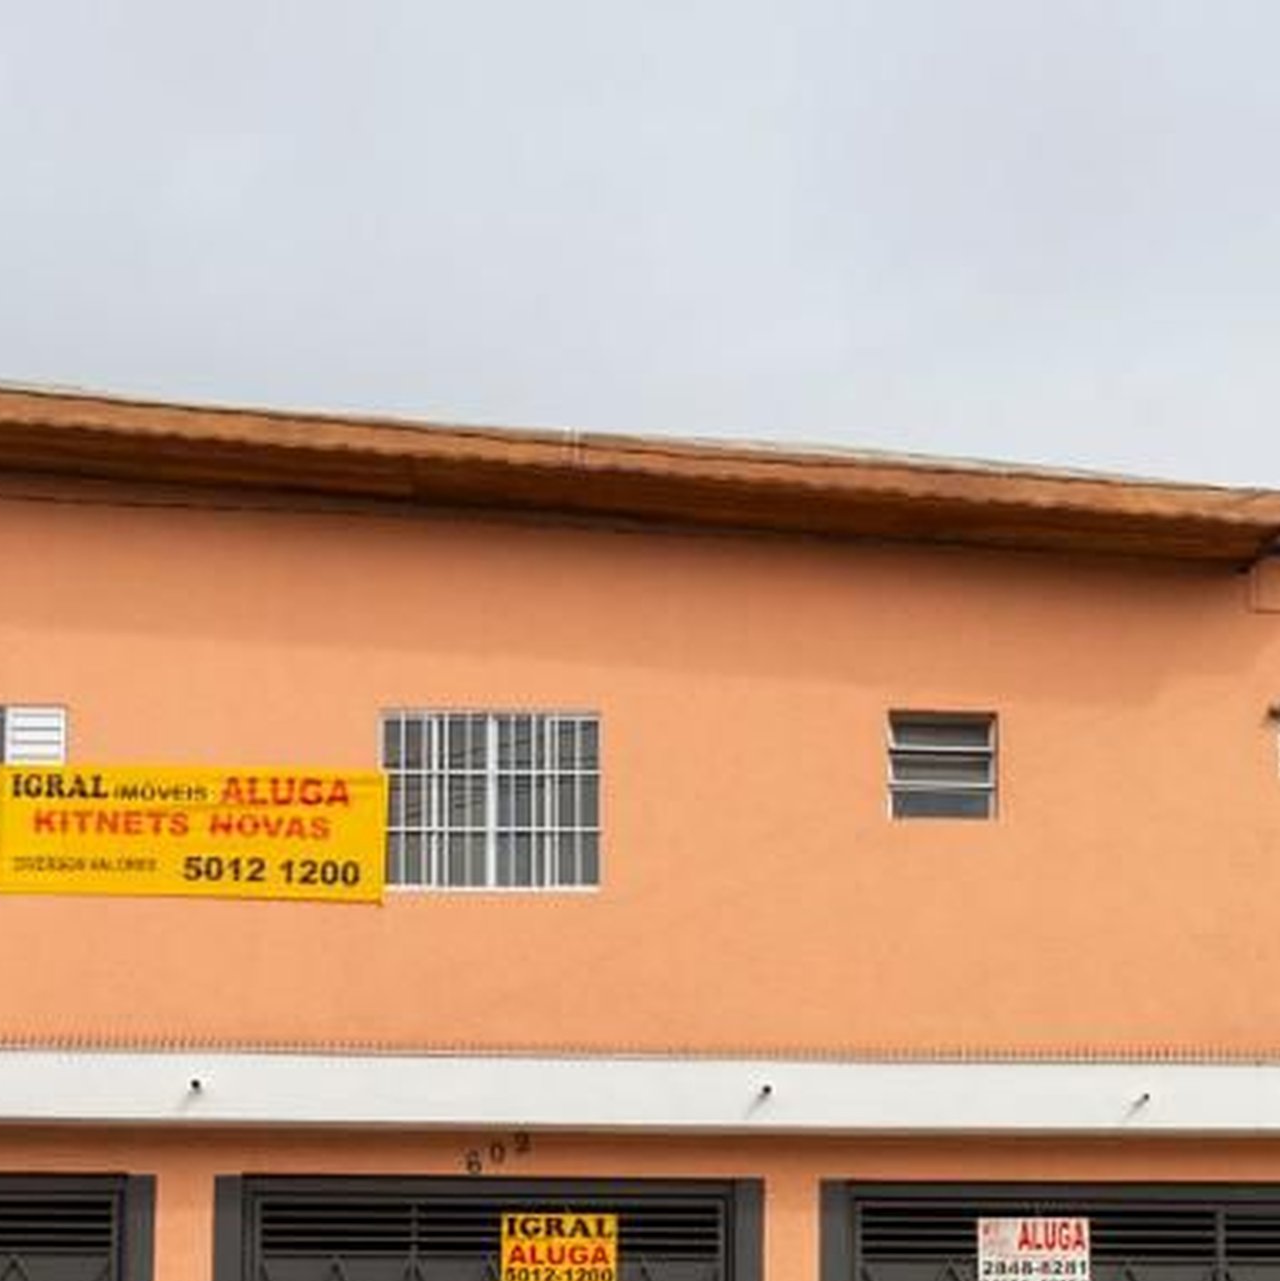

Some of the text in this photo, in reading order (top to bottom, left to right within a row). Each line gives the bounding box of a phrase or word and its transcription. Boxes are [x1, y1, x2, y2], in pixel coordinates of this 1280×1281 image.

[12, 773, 109, 799] IGRAL
[221, 776, 350, 807] ALUGA
[34, 809, 331, 841] KITNETS NOVAS
[183, 855, 362, 887] 5012 1200
[506, 1217, 613, 1239] IGRAL
[1018, 1221, 1086, 1251] ALUGA
[508, 1245, 611, 1266] ALUGA
